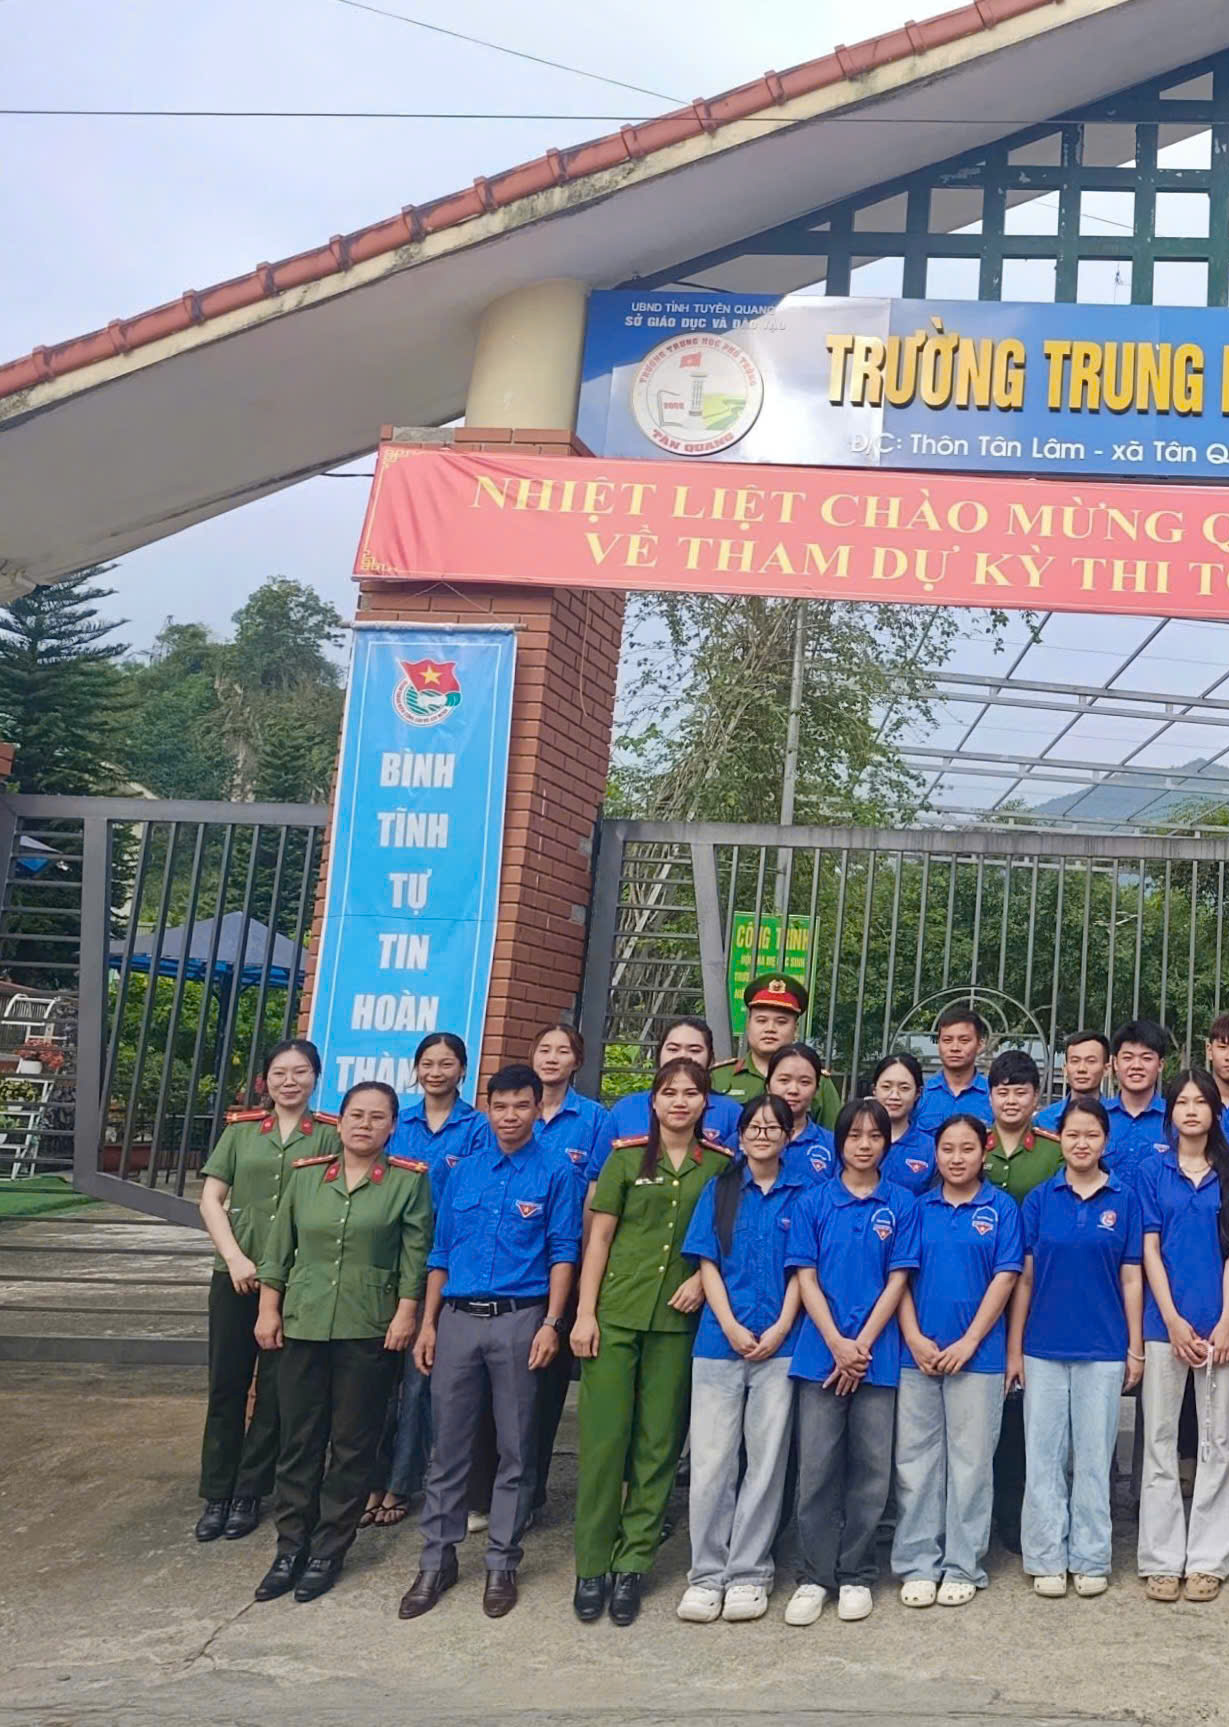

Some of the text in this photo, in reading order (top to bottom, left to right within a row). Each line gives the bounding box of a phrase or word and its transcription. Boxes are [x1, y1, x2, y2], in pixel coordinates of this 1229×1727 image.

[625, 313, 643, 327] SỞ
[647, 314, 676, 328] GIÁO
[681, 318, 707, 331] DỤC
[712, 316, 727, 329] VÀ
[631, 302, 662, 313] UBND
[665, 300, 690, 313] TỈNH
[694, 301, 731, 314] TUYÊN
[825, 315, 1027, 412] TRƯỜNG
[1043, 340, 1205, 417] TRUNG
[684, 432, 735, 452] QUANG
[850, 432, 902, 457] Đ/C:
[910, 433, 969, 456] Thôn
[978, 435, 1022, 458] Tân
[1032, 436, 1086, 460] Lâm
[1111, 440, 1144, 462] xã
[1153, 440, 1197, 463] Tân
[470, 475, 658, 524] NHIỆT
[671, 484, 808, 531] LIỆT
[820, 488, 990, 535] CHÀO
[1006, 496, 1186, 545] MỪNG
[584, 523, 660, 568] VỀ
[678, 535, 857, 579] THAM
[871, 544, 962, 592] DỰ
[972, 544, 1057, 589] KỲ
[1071, 556, 1172, 595] THI
[379, 747, 457, 788] BÌNH
[376, 807, 449, 848] TĨNH
[388, 868, 433, 916] TỰ
[378, 933, 430, 970] TIN
[351, 989, 440, 1033] HOÀN
[335, 1050, 425, 1095] THÀN
